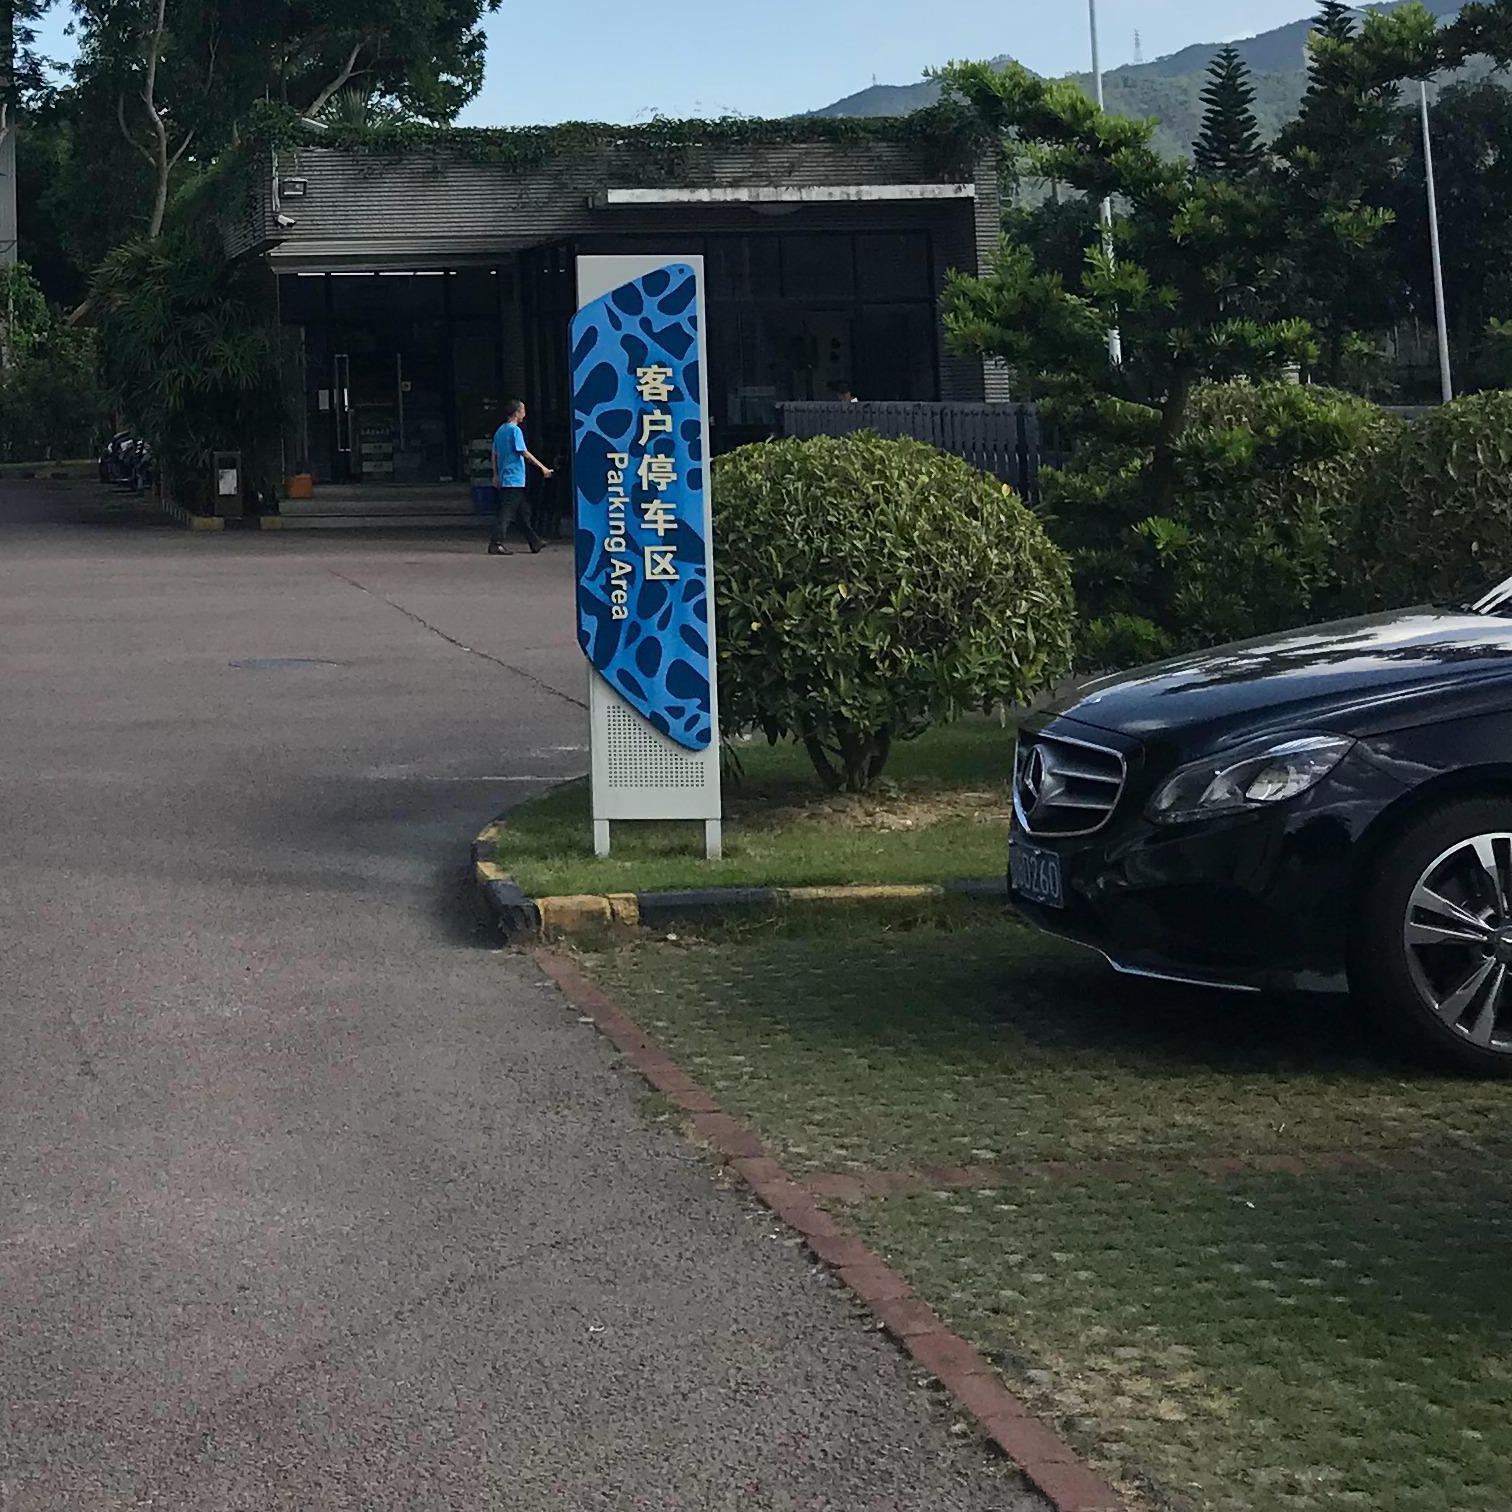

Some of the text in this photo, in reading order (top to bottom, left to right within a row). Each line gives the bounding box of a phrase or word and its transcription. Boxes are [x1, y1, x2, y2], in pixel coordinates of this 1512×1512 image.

[604, 452, 632, 620] Parking Area
[636, 364, 680, 580] 客户停车区
